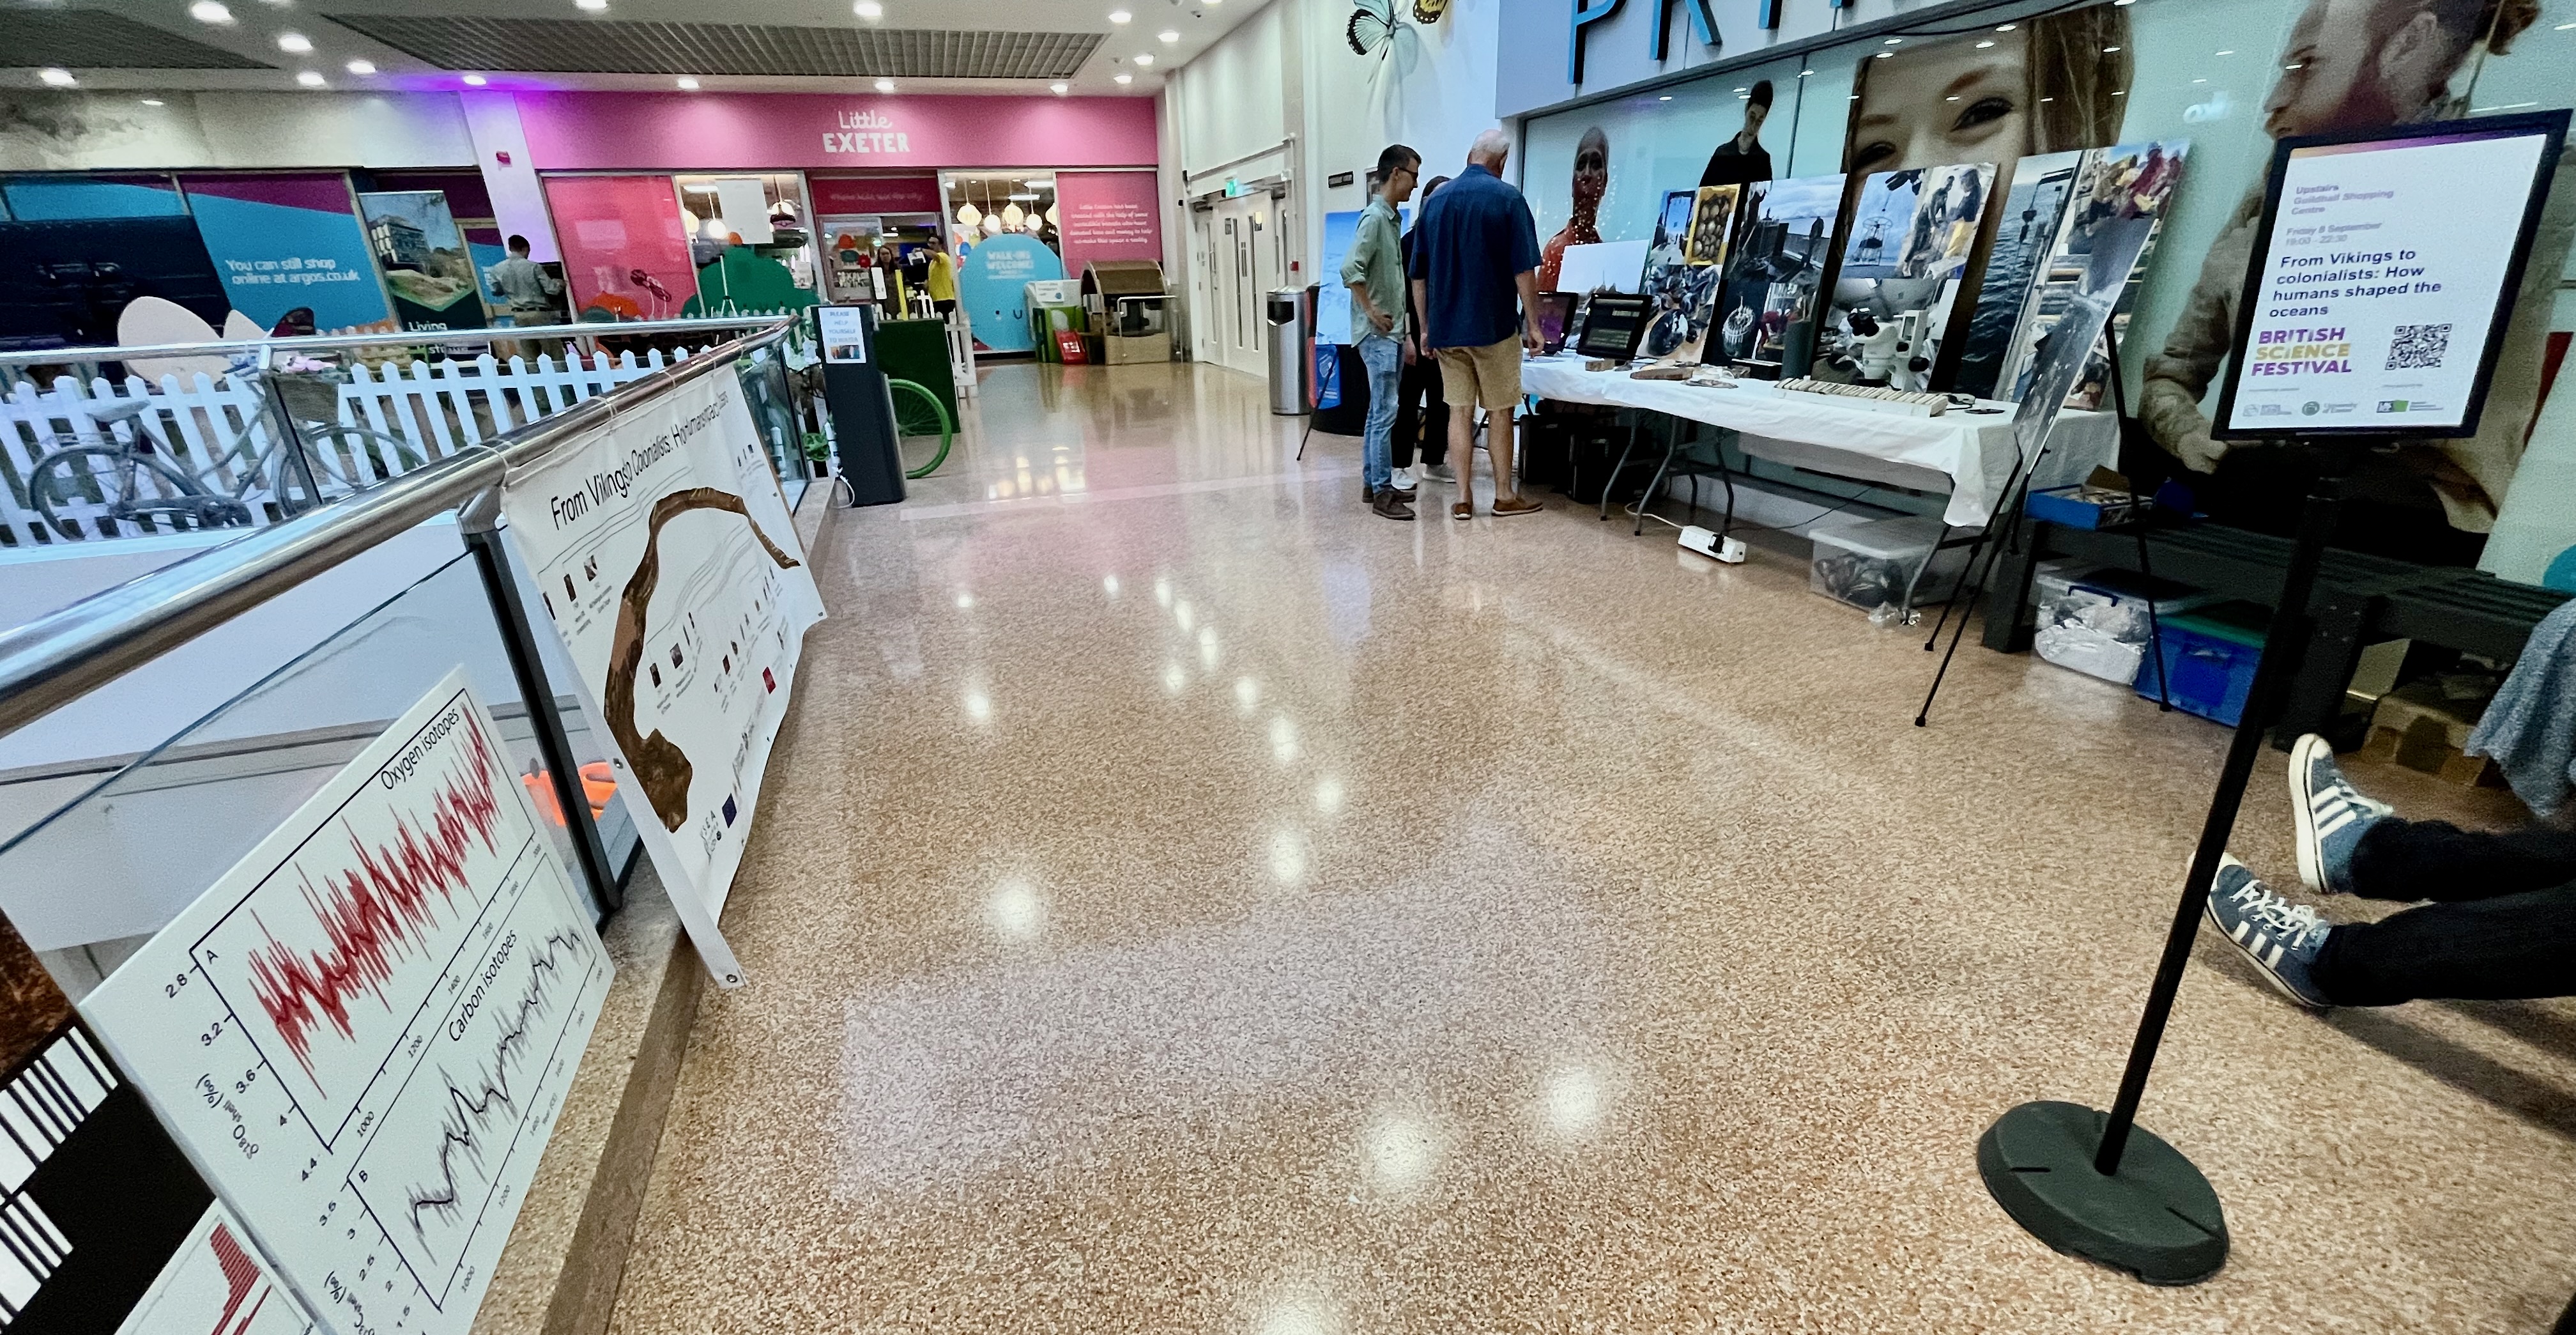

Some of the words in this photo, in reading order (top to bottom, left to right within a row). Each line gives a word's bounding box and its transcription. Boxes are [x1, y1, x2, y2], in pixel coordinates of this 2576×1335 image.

[838, 110, 892, 129] Little
[822, 132, 910, 153] EXETER
[2296, 184, 2339, 194] Upstairs
[2342, 190, 2394, 201] Shopping
[2291, 206, 2326, 215] Centre
[226, 259, 253, 272] You
[255, 260, 279, 270] can
[281, 257, 302, 270] still
[304, 259, 336, 270] shop
[2281, 256, 2324, 268] From
[2331, 251, 2393, 265] Vikings
[2400, 249, 2416, 260] to
[232, 273, 272, 284] online
[273, 273, 288, 284] at
[289, 269, 361, 286] argos.co.uk
[2276, 268, 2379, 285] colonialists:
[2384, 266, 2425, 278] How
[2273, 288, 2339, 302] humans
[2345, 282, 2409, 298] shaped
[2414, 281, 2442, 293] the
[2269, 305, 2329, 317] oceans
[2258, 327, 2345, 344] BRITISH
[2255, 343, 2351, 360] SCIENCE
[2251, 360, 2352, 376] FESTIVAL
[551, 496, 588, 531] From
[381, 745, 424, 790] Oxygen
[419, 708, 459, 752] isotopes
[206, 950, 218, 964] A
[165, 973, 188, 998] 2.8
[449, 985, 486, 1042] Carbon
[480, 929, 517, 988] isotopes
[201, 1022, 224, 1046] 3.2
[408, 1035, 424, 1058] 1200
[235, 1069, 256, 1093] 3.6
[280, 1114, 288, 1127] 4
[356, 1111, 374, 1138] 1000
[301, 1157, 318, 1182] 4.4
[358, 1169, 368, 1183] B
[498, 1184, 511, 1209] 1200
[319, 1200, 336, 1226] 3.5
[347, 1228, 356, 1240] 3
[358, 1253, 374, 1281] 2.5
[385, 1280, 394, 1293] 2
[462, 1265, 475, 1294] 1000
[396, 1304, 410, 1328] 1.5
